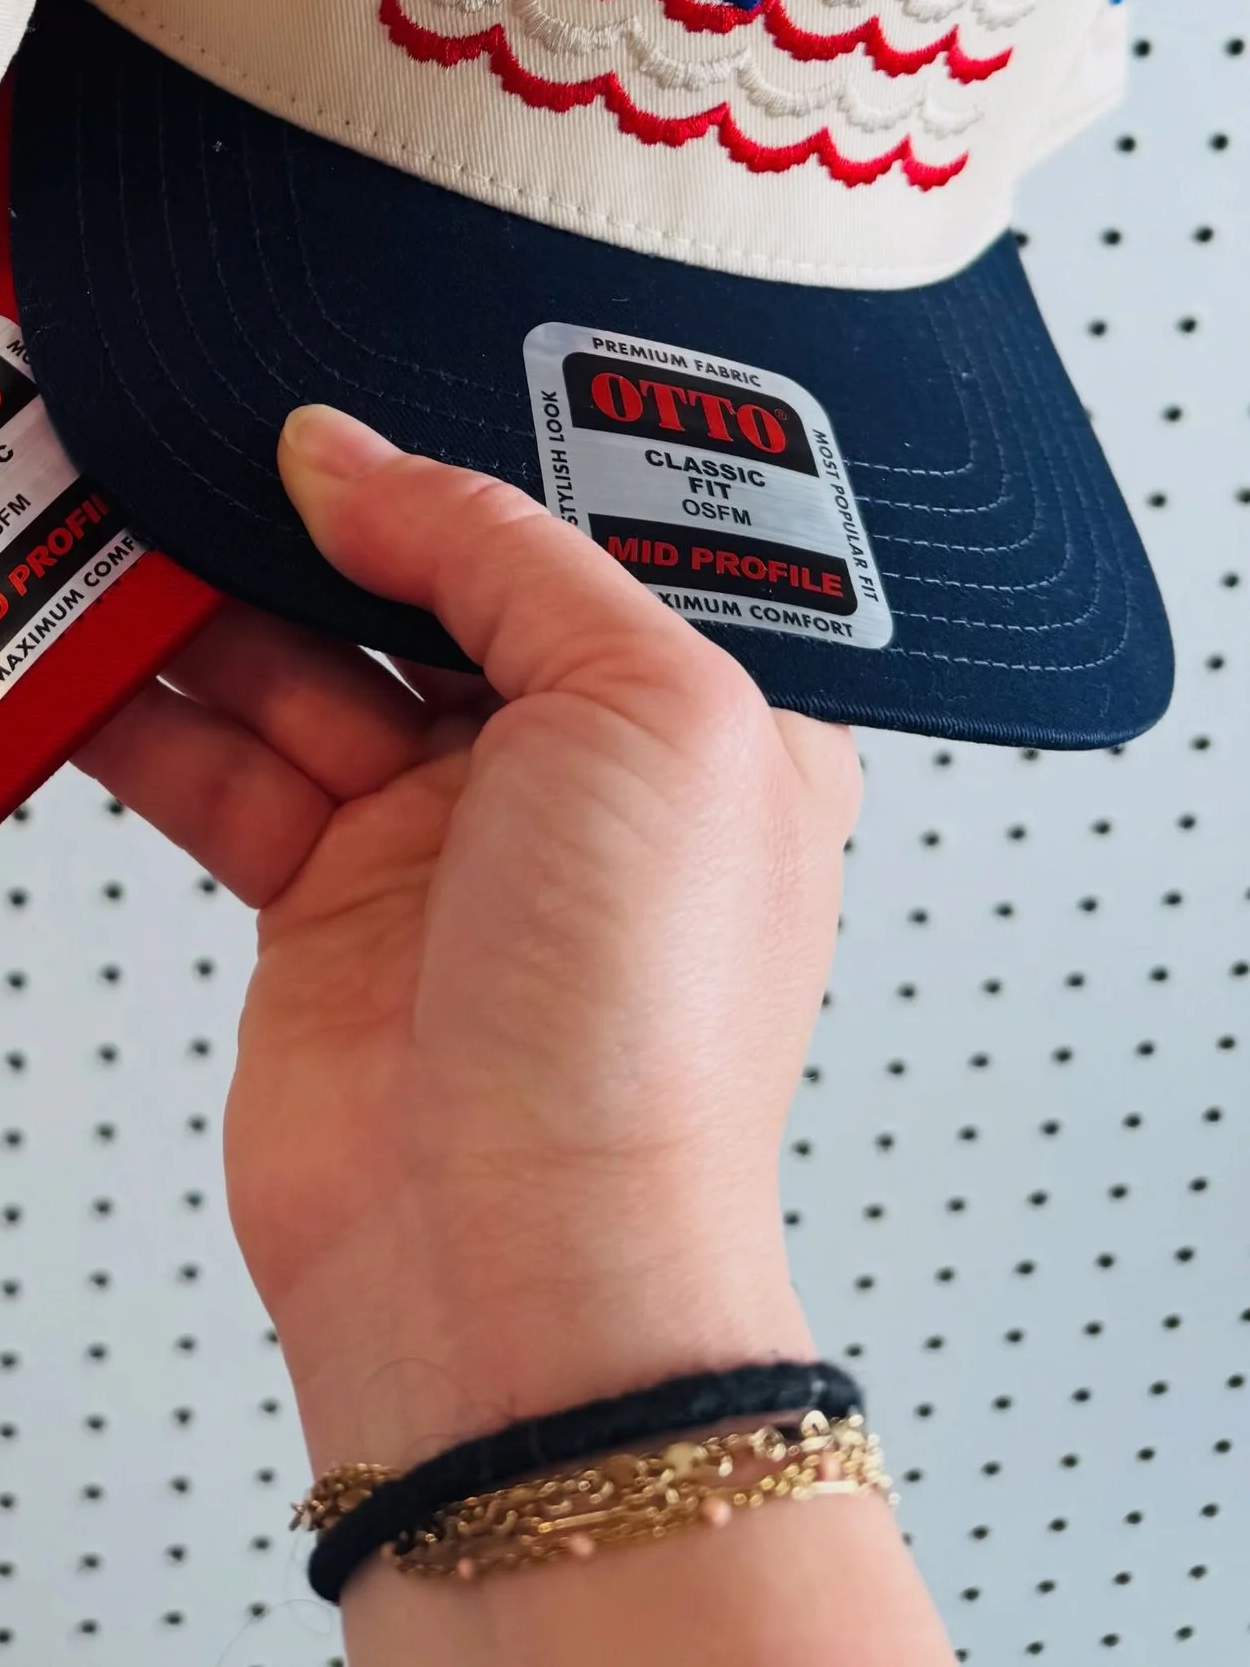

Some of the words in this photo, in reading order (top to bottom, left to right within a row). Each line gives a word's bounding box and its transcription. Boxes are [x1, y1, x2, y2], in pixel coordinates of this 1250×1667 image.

[592, 336, 688, 369] PREMIUM
[695, 359, 762, 388] FABRIC
[541, 391, 566, 443] LOOK
[591, 372, 787, 454] OTTO
[551, 449, 579, 526] STYLISH
[644, 449, 766, 488] CLASSIC
[689, 476, 732, 500] FIT
[681, 498, 752, 526] OSFM
[812, 428, 841, 480] MOST
[834, 483, 869, 570] POPULAR
[858, 575, 880, 603] FIT
[84, 536, 138, 587] COMF
[607, 536, 679, 567] MID
[691, 547, 845, 598] PROFILE
[657, 592, 743, 618] XIMUM
[750, 605, 854, 639] COMFORT
